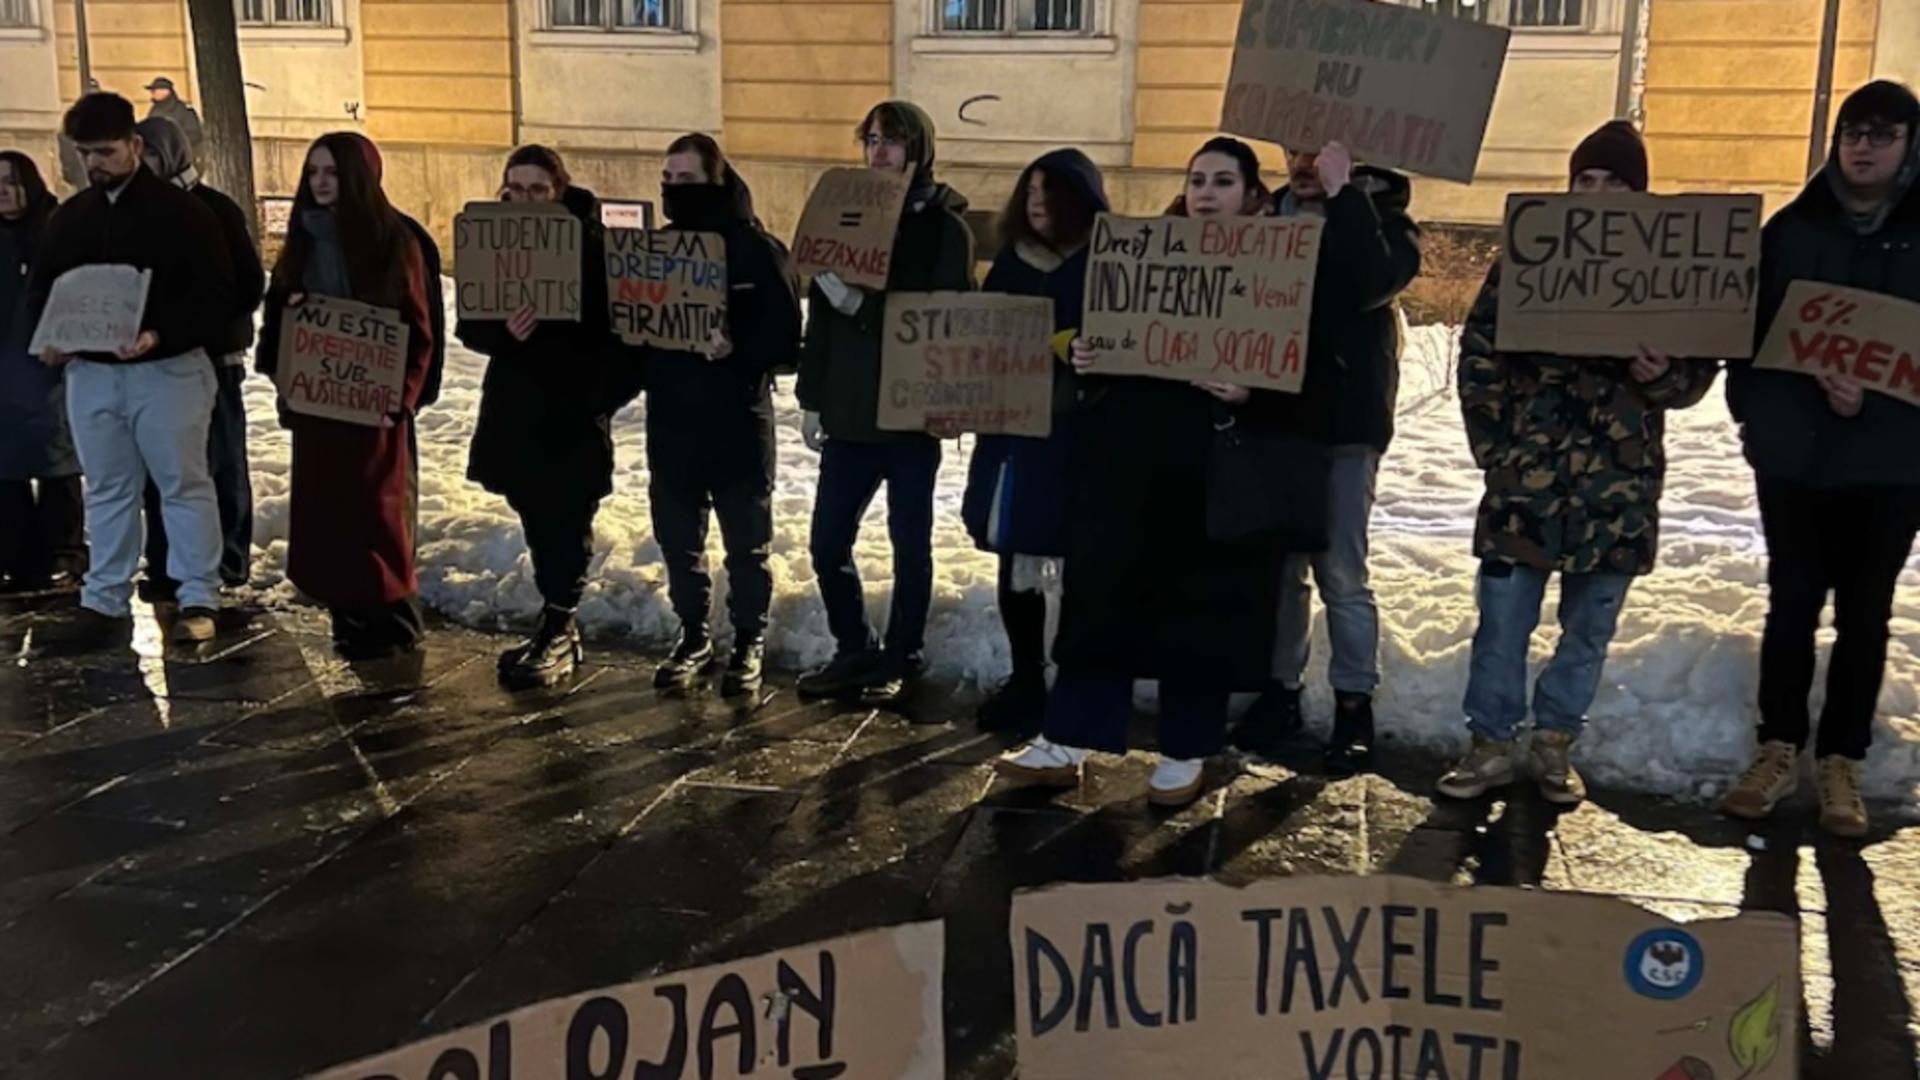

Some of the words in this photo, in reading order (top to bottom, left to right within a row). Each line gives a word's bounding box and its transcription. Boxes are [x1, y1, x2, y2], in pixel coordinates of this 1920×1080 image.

[1313, 61, 1364, 98] NU
[610, 228, 708, 259] VREM
[1163, 222, 1188, 256] la
[1508, 200, 1753, 266] GREVELE
[495, 249, 533, 280] NU
[616, 277, 669, 305] NU
[1089, 261, 1233, 319] INDIFERENT
[1515, 259, 1610, 309] SUNT
[1799, 292, 1858, 326] 6%
[296, 306, 332, 328] NU
[338, 312, 398, 347] ESTE
[1088, 334, 1116, 351] sau
[1121, 327, 1137, 351] de
[318, 356, 369, 383] SUB
[1024, 901, 1200, 1038] DACĂ
[1242, 904, 1508, 1017] TAXELE
